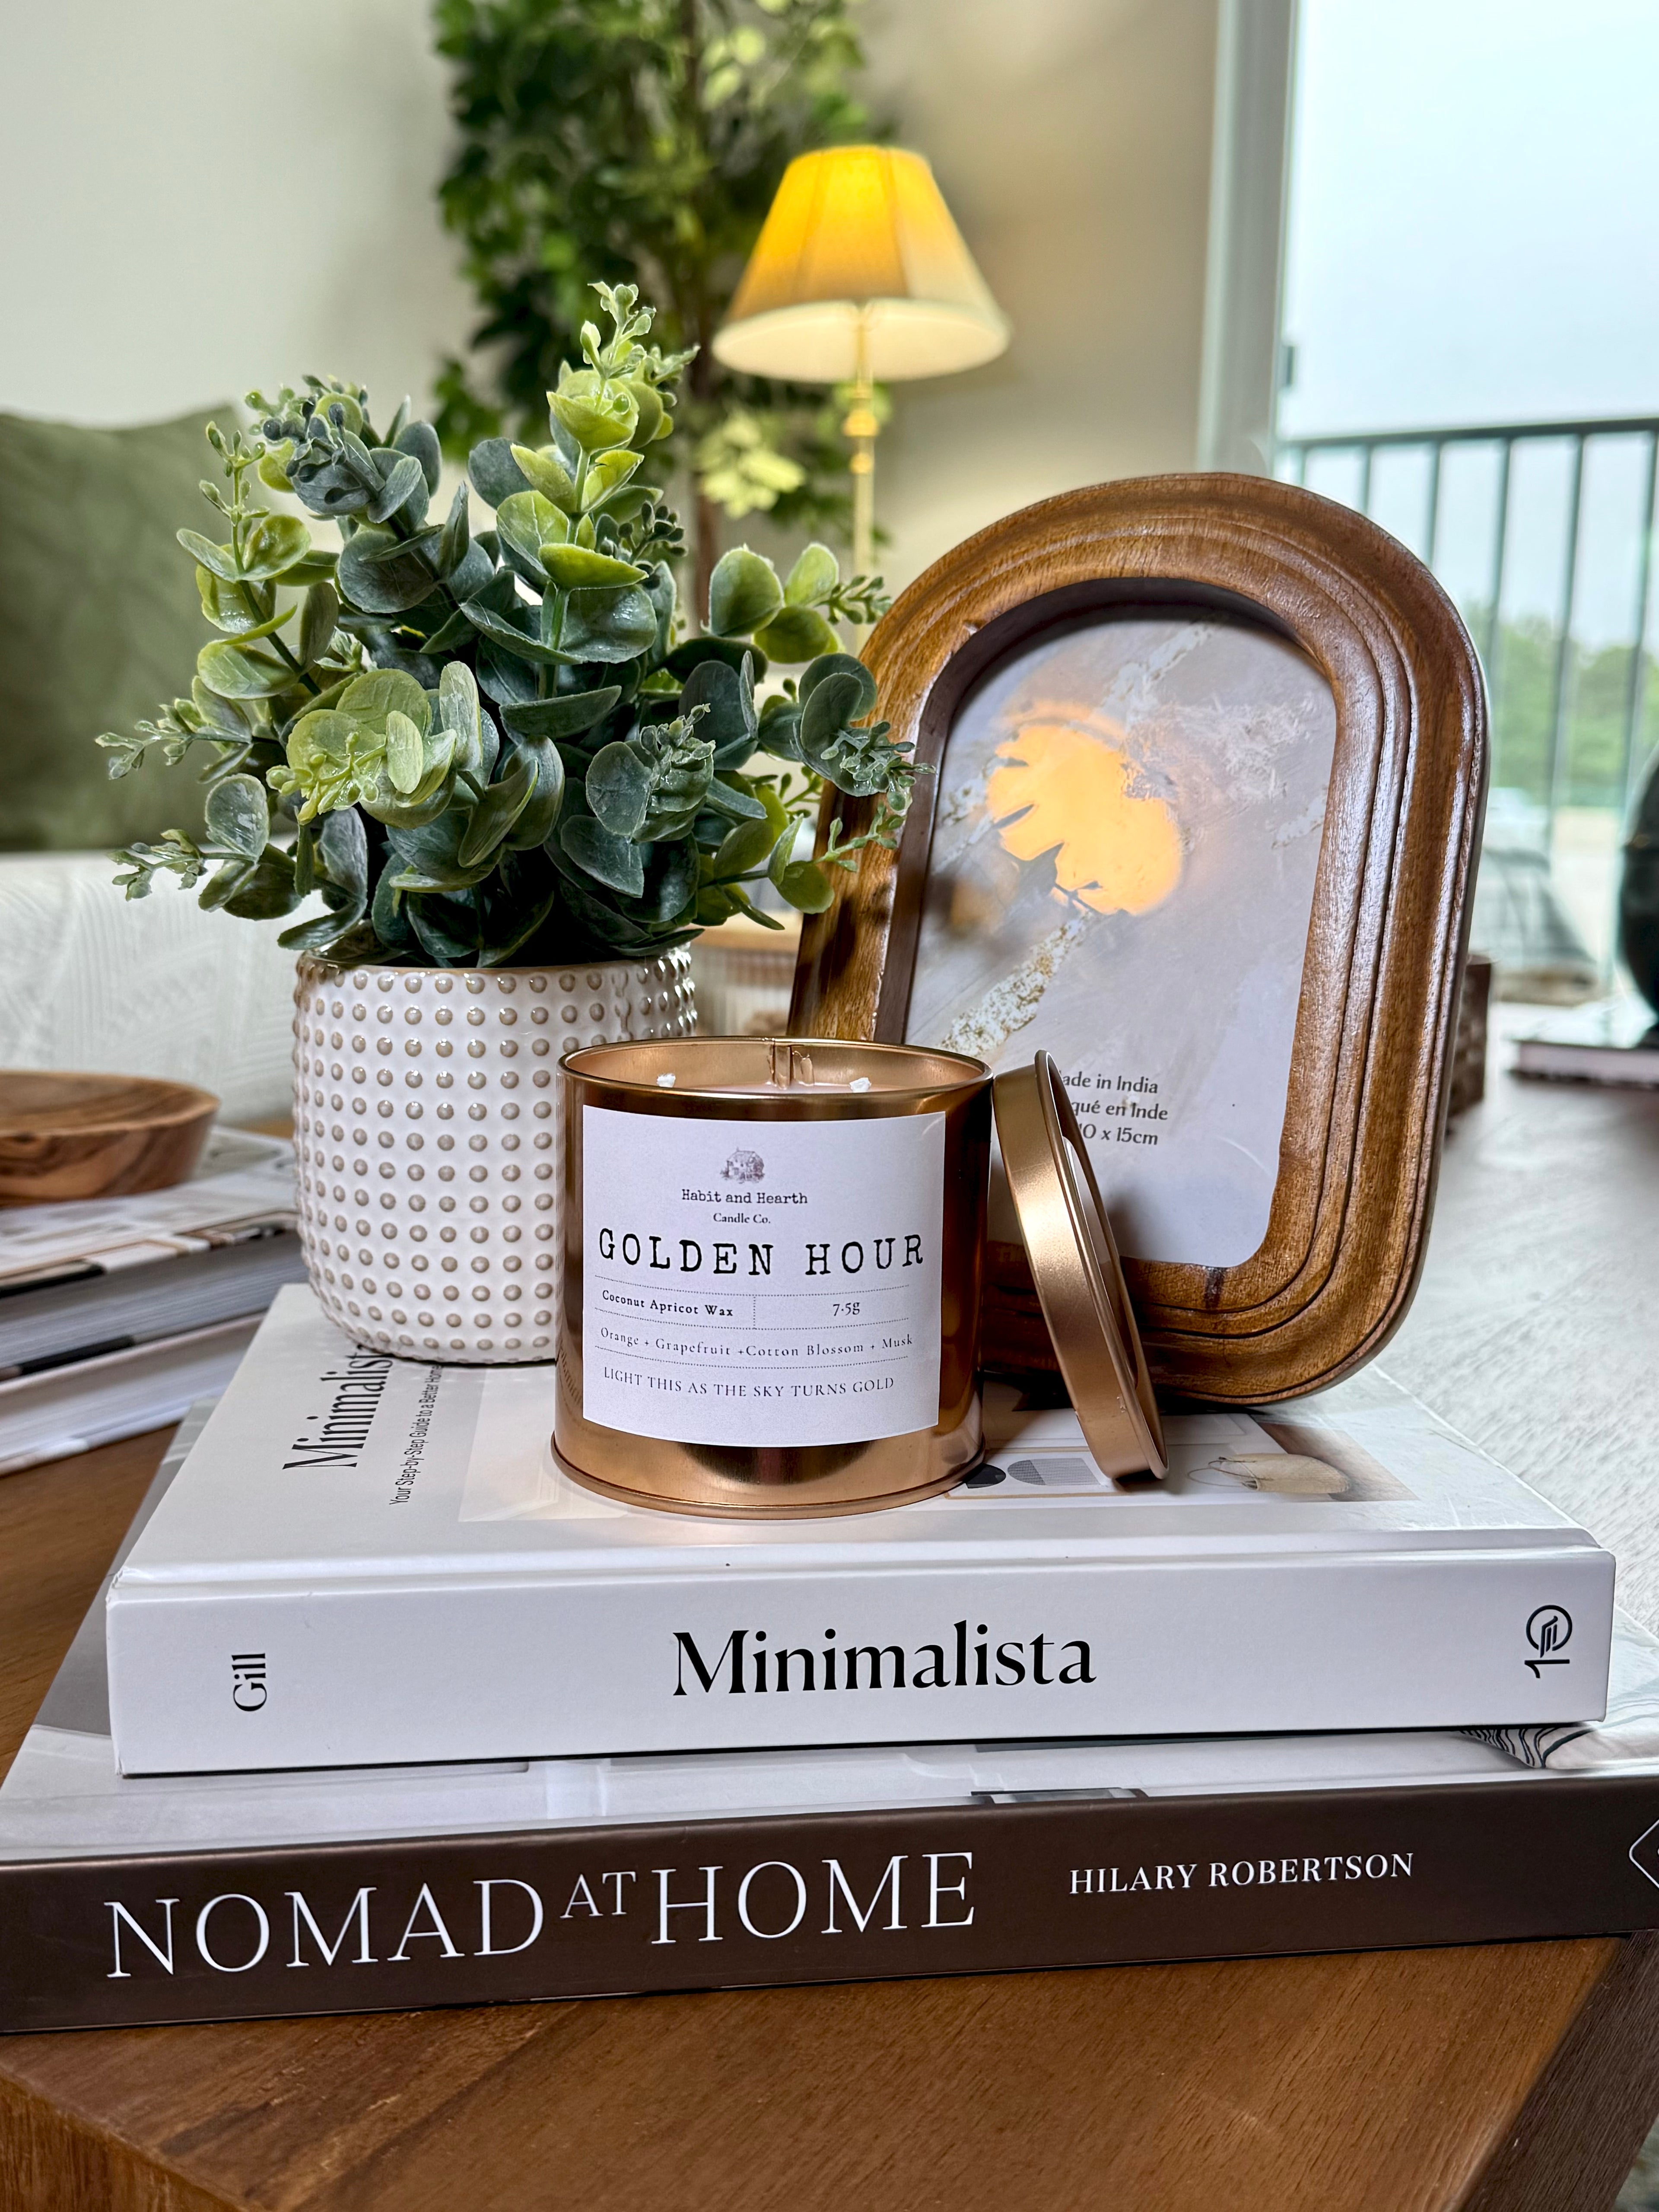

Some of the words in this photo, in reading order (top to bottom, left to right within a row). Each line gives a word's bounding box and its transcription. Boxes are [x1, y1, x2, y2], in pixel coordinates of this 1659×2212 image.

[1060, 1071, 1091, 1088] ade
[1096, 1074, 1112, 1090] in
[1116, 1075, 1158, 1094] India
[1106, 1104, 1125, 1116] en
[1131, 1102, 1168, 1121] Inde
[1101, 1129, 1111, 1141] x
[1116, 1127, 1158, 1145] 15cm
[682, 1189, 721, 1202] Habit
[725, 1192, 752, 1203] and
[756, 1192, 808, 1204] Hearth
[713, 1213, 750, 1223] Candle
[753, 1214, 770, 1224] Co.
[599, 1228, 774, 1275] GOLDEN
[805, 1234, 924, 1275] HOUR
[602, 1290, 645, 1307] Coconut
[650, 1300, 699, 1314] Apricot
[705, 1305, 733, 1316] Wax
[601, 1327, 639, 1347] Orange
[656, 1338, 730, 1355] Grapefruit
[807, 1344, 864, 1355] Blossom
[882, 1334, 912, 1348] Musk
[418, 1384, 439, 1403] Better
[604, 1367, 642, 1385] LIGHT
[648, 1376, 681, 1392] THIS
[688, 1382, 707, 1394] AS
[713, 1384, 747, 1396] THE
[753, 1385, 784, 1397] SKY
[791, 1382, 847, 1397] TURNS
[852, 1377, 894, 1393] GOLD
[282, 1343, 393, 1470] Minimalist
[409, 1418, 430, 1437] Guide
[395, 1439, 429, 1485] Step-by-Step
[389, 1487, 412, 1505] Your
[672, 1619, 1097, 1696] Minimalista
[232, 1653, 267, 1712] Gill
[1070, 1864, 1197, 1894] HILARY
[1209, 1853, 1414, 1887] ROBERTSON
[104, 1879, 543, 1978] NOMAD
[560, 1871, 636, 1919] AT
[652, 1851, 975, 1944] HOME
